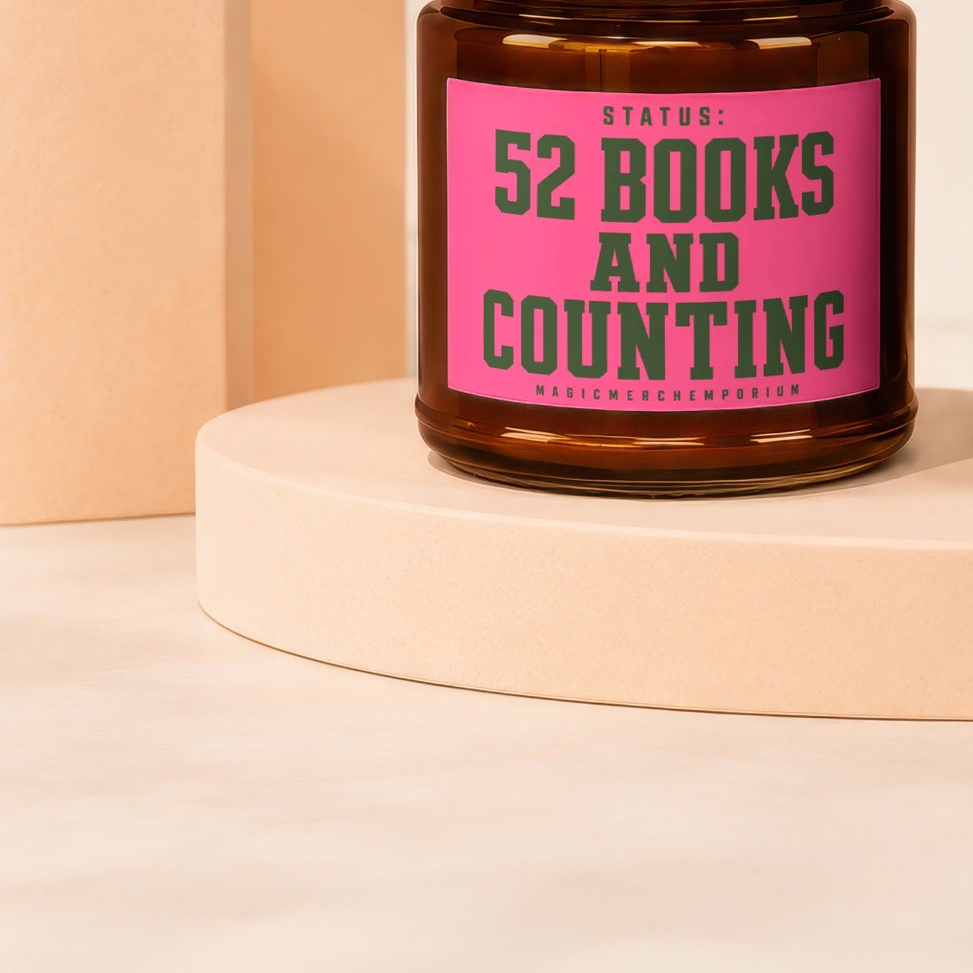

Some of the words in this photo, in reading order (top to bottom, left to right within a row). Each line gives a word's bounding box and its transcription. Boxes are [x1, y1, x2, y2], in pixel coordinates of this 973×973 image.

[603, 105, 724, 126] STATUS:
[494, 128, 576, 220] 52
[600, 130, 835, 224] BOOKS
[589, 231, 740, 293] AND
[483, 288, 845, 381] COUNTING
[535, 383, 800, 402] MAGICMERCHEMPORIUM
